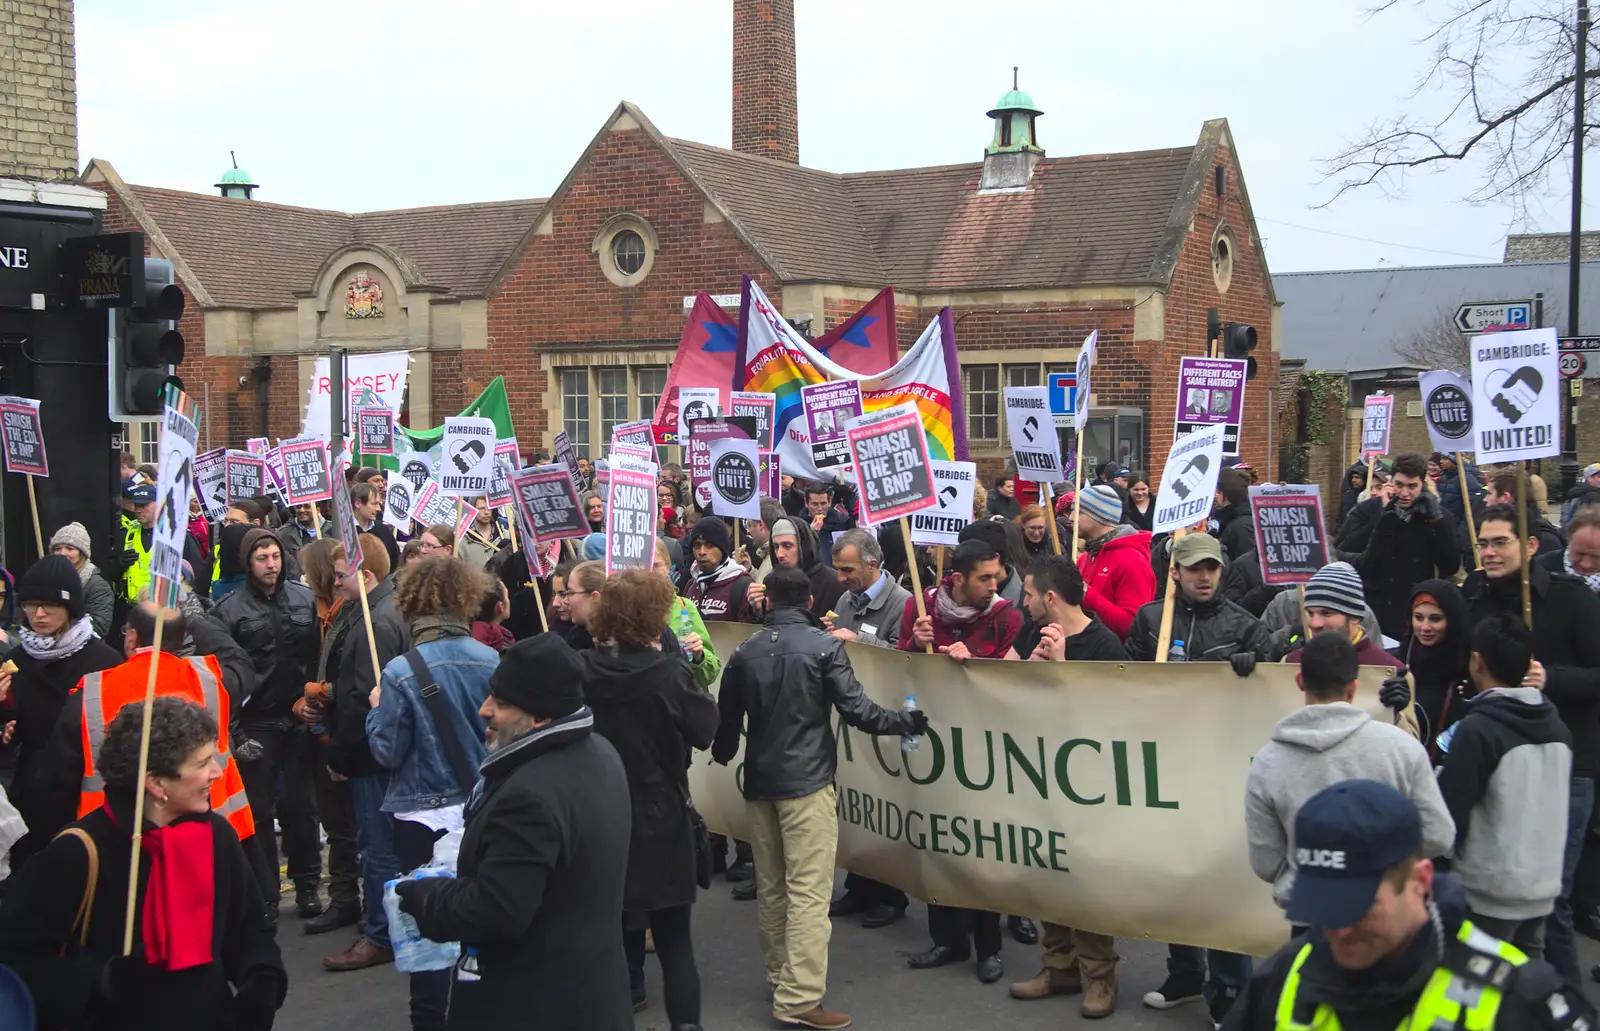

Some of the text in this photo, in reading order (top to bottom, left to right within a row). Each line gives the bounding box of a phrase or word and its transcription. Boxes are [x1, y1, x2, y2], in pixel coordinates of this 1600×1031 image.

[1476, 308, 1504, 317] Short
[1478, 342, 1550, 362] CAMBRIDGE:
[1561, 358, 1578, 369] 20
[1184, 368, 1242, 379] DIFFERENT FACES
[319, 373, 399, 394] RMSEY
[1186, 377, 1237, 387] SAME HATRED!
[806, 391, 838, 403] DIFFERENT
[840, 388, 857, 397] FACES
[810, 397, 855, 410] SAME HATRED!
[1007, 398, 1045, 409] CAMBRIDGE:
[734, 405, 765, 418] SMASH
[1432, 408, 1467, 422] UNITE
[4, 412, 32, 429] SMASH
[362, 416, 386, 425] SMASH
[6, 427, 40, 444] THE EDL
[363, 425, 390, 434] THE EDL
[448, 426, 492, 435] CAMBRIDGE:
[113, 436, 120, 447] 3
[364, 434, 384, 444] & BNP
[620, 432, 646, 444] SMASH
[664, 433, 678, 442] pc
[692, 439, 706, 451] No
[856, 429, 911, 461] SMASH
[1482, 424, 1552, 451] UNITED!
[10, 442, 34, 457] & BNP
[825, 441, 842, 450] RACIST
[285, 449, 318, 466] SMASH
[860, 448, 924, 480] THE EDL
[1015, 451, 1056, 470] UNITED!
[229, 464, 257, 476] SMASH
[287, 461, 325, 477] THE EDL
[718, 468, 751, 476] CAMBRIDGE
[934, 469, 971, 481] MBRIDGE:
[230, 474, 261, 488] THE EDL
[290, 475, 318, 490] & BNP
[443, 476, 487, 489] UNITED!
[719, 474, 751, 489] UNITE
[866, 471, 913, 501] & BNP
[230, 485, 254, 498] & BNP
[521, 482, 564, 500] SMASH
[614, 484, 648, 511] SMASH
[390, 496, 408, 512] UNITE
[420, 493, 444, 522] SMASH
[439, 496, 455, 513] EDL
[526, 495, 575, 513] THE EDL
[1158, 496, 1208, 523] UNITED!
[444, 508, 458, 527] BNP
[533, 510, 569, 527] & BNP
[613, 509, 651, 535] THE EDL
[1259, 507, 1309, 526] SMASH
[1261, 526, 1319, 544] THE EDL
[612, 533, 644, 558] & BNP
[1266, 545, 1310, 563] & BNP
[871, 726, 1180, 810] COUNCIL
[838, 784, 1069, 873] MBRIDGESHIRE
